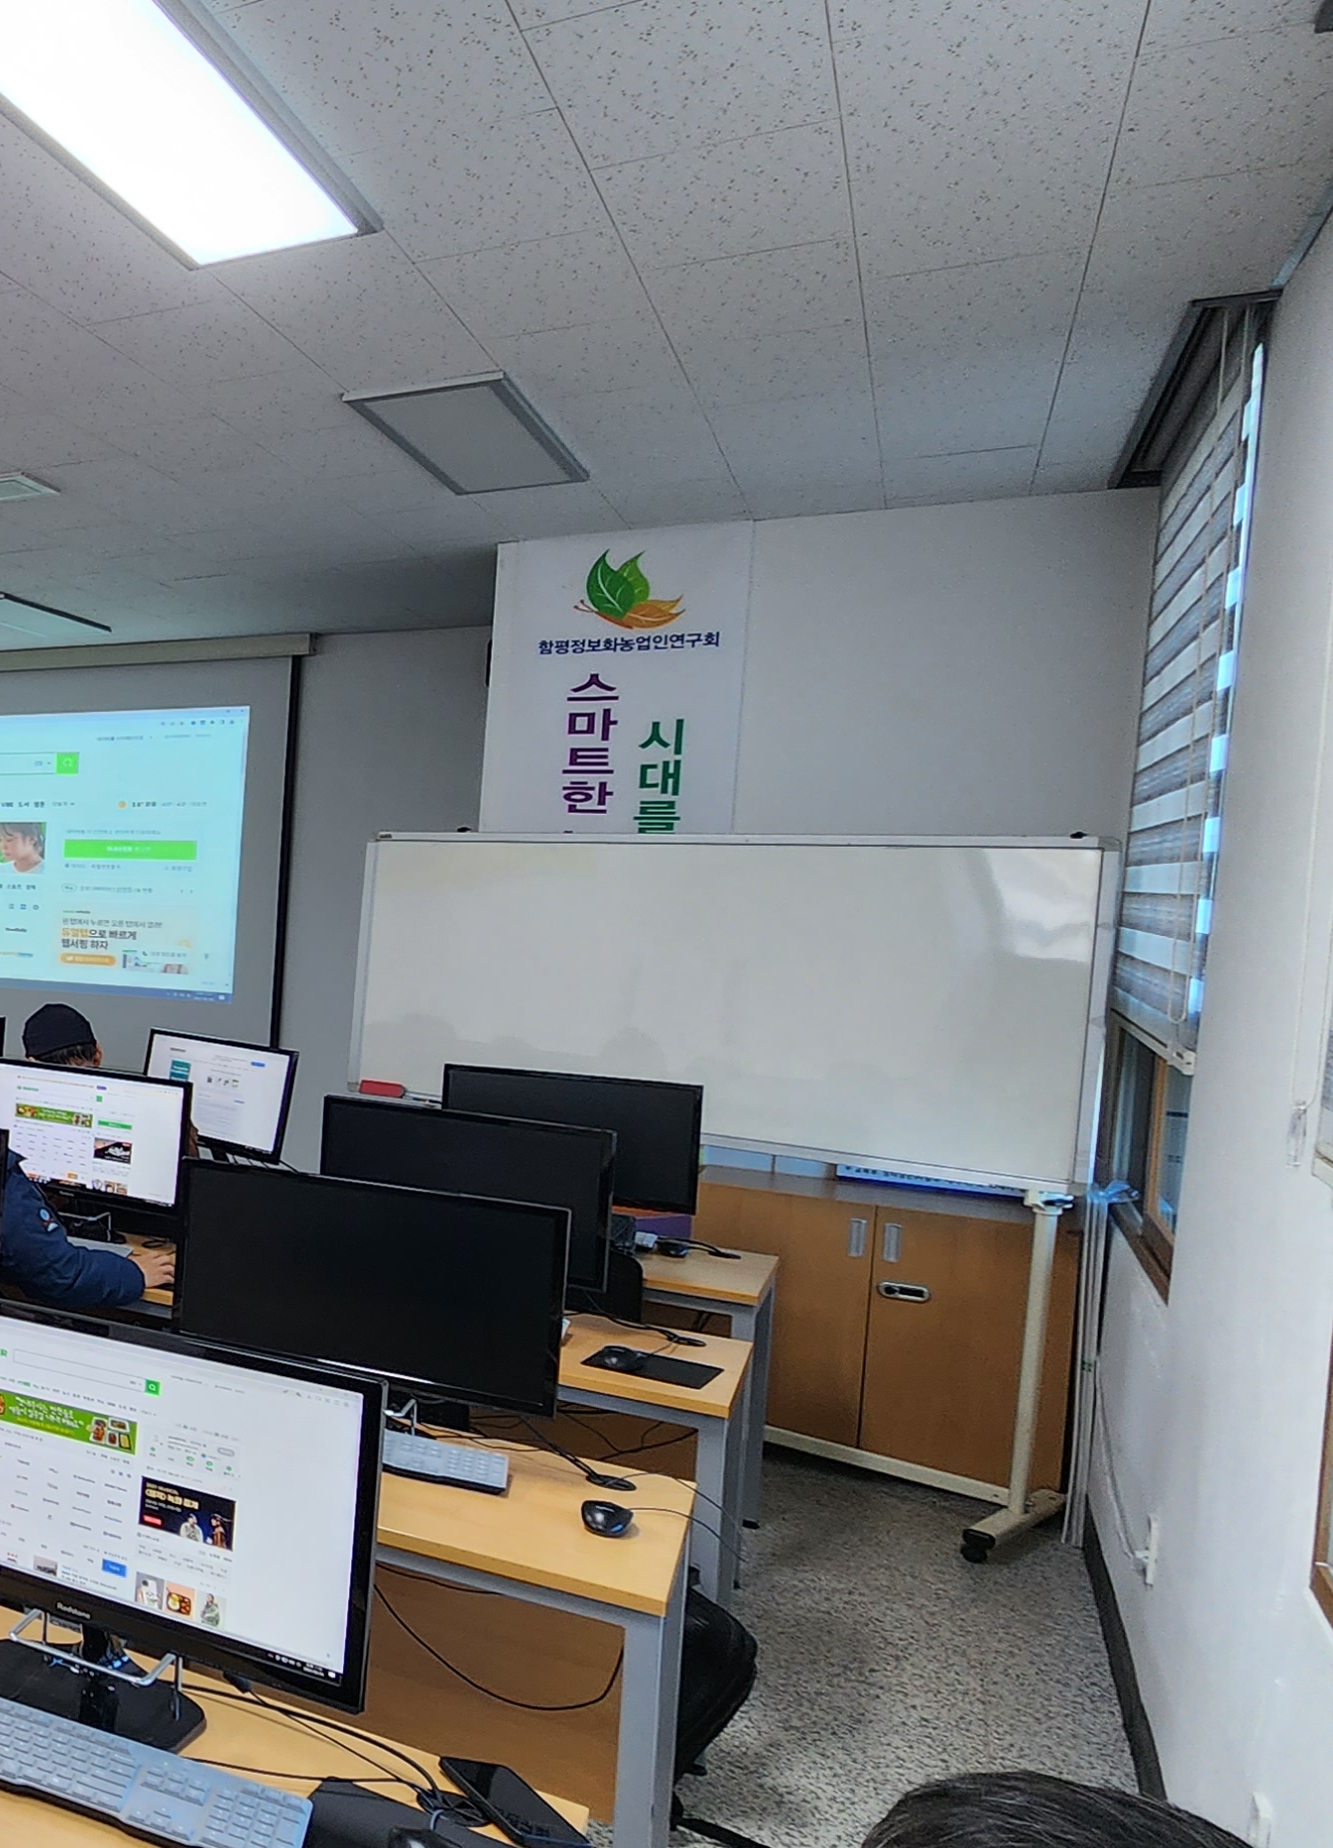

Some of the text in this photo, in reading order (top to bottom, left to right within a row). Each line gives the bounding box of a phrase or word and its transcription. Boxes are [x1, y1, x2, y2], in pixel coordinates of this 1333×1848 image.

[538, 631, 720, 655] 함평정보화농업인연구회
[562, 673, 619, 814] 스마트한
[633, 719, 684, 834] 시대를
